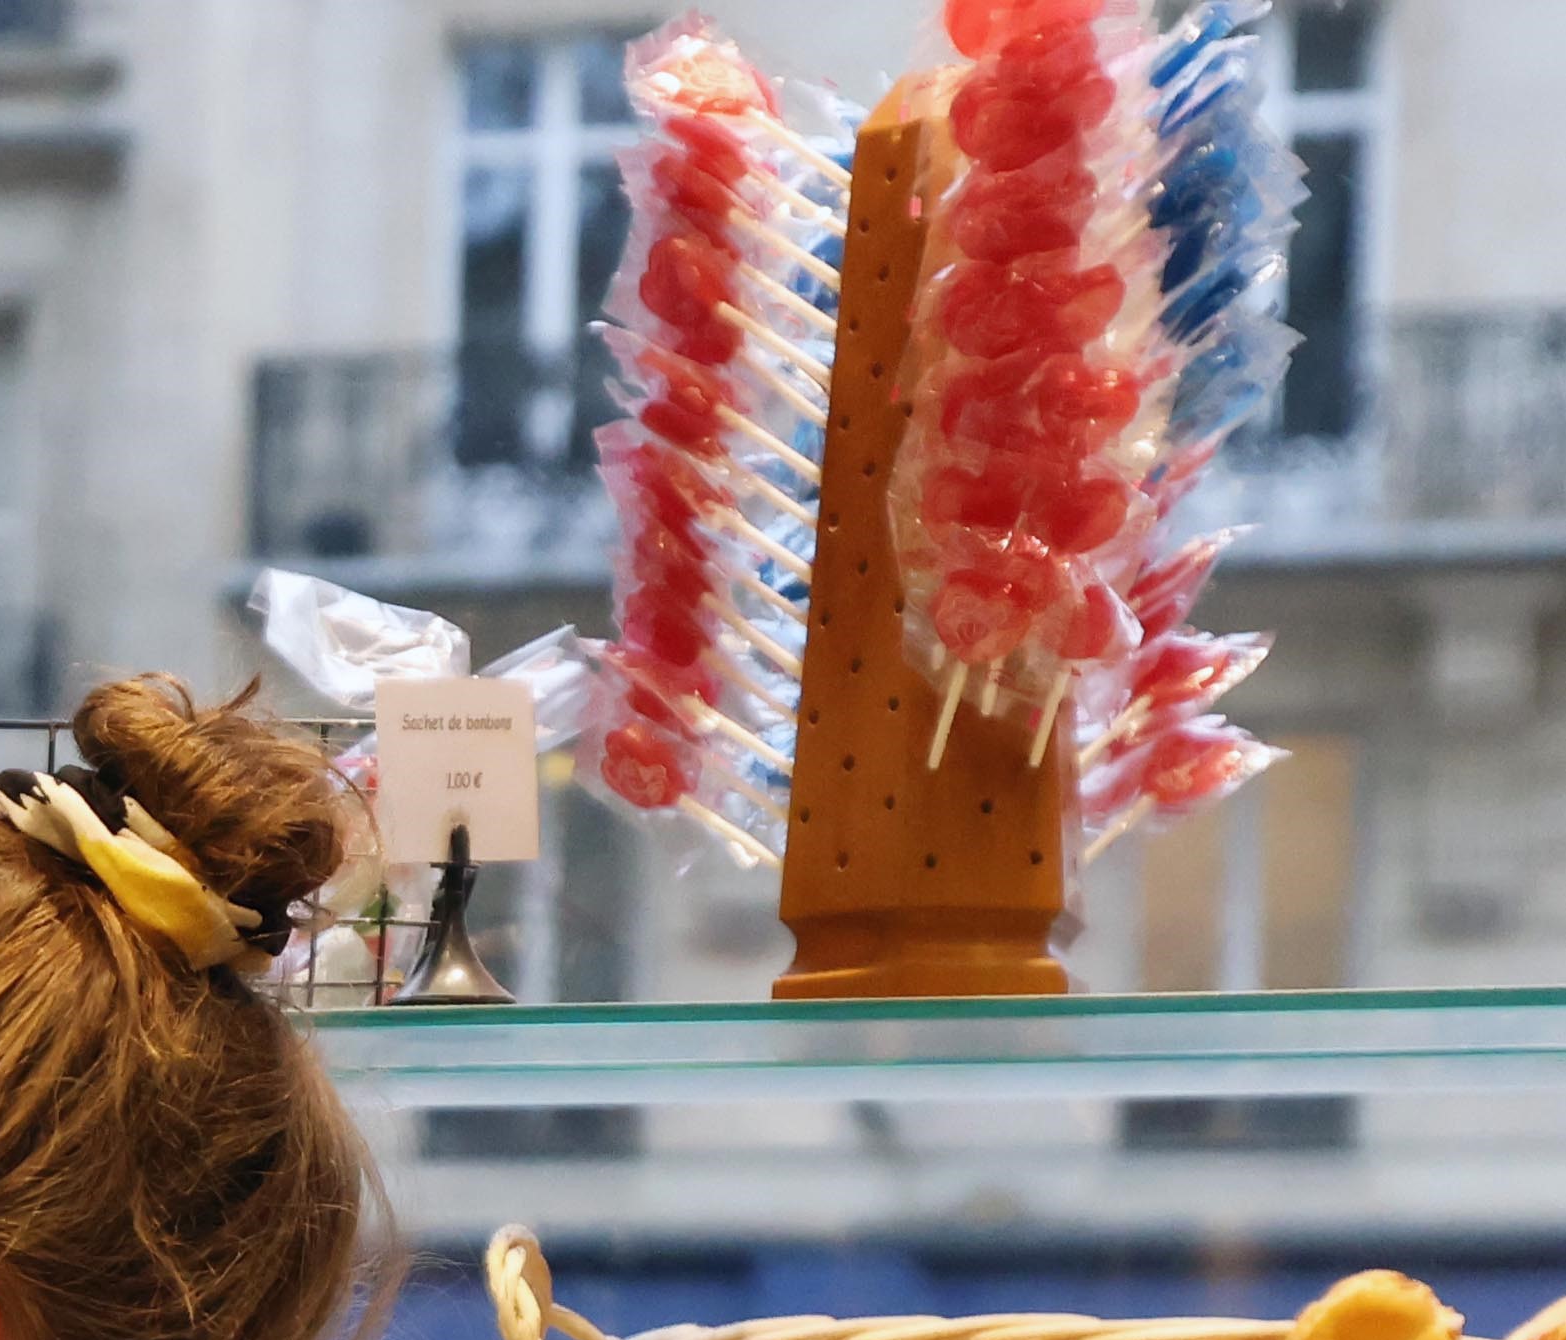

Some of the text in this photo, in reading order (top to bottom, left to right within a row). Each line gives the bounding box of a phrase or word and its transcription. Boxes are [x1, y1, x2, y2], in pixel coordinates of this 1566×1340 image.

[402, 711, 513, 731] Sachet de bonbons
[473, 771, 484, 790] €
